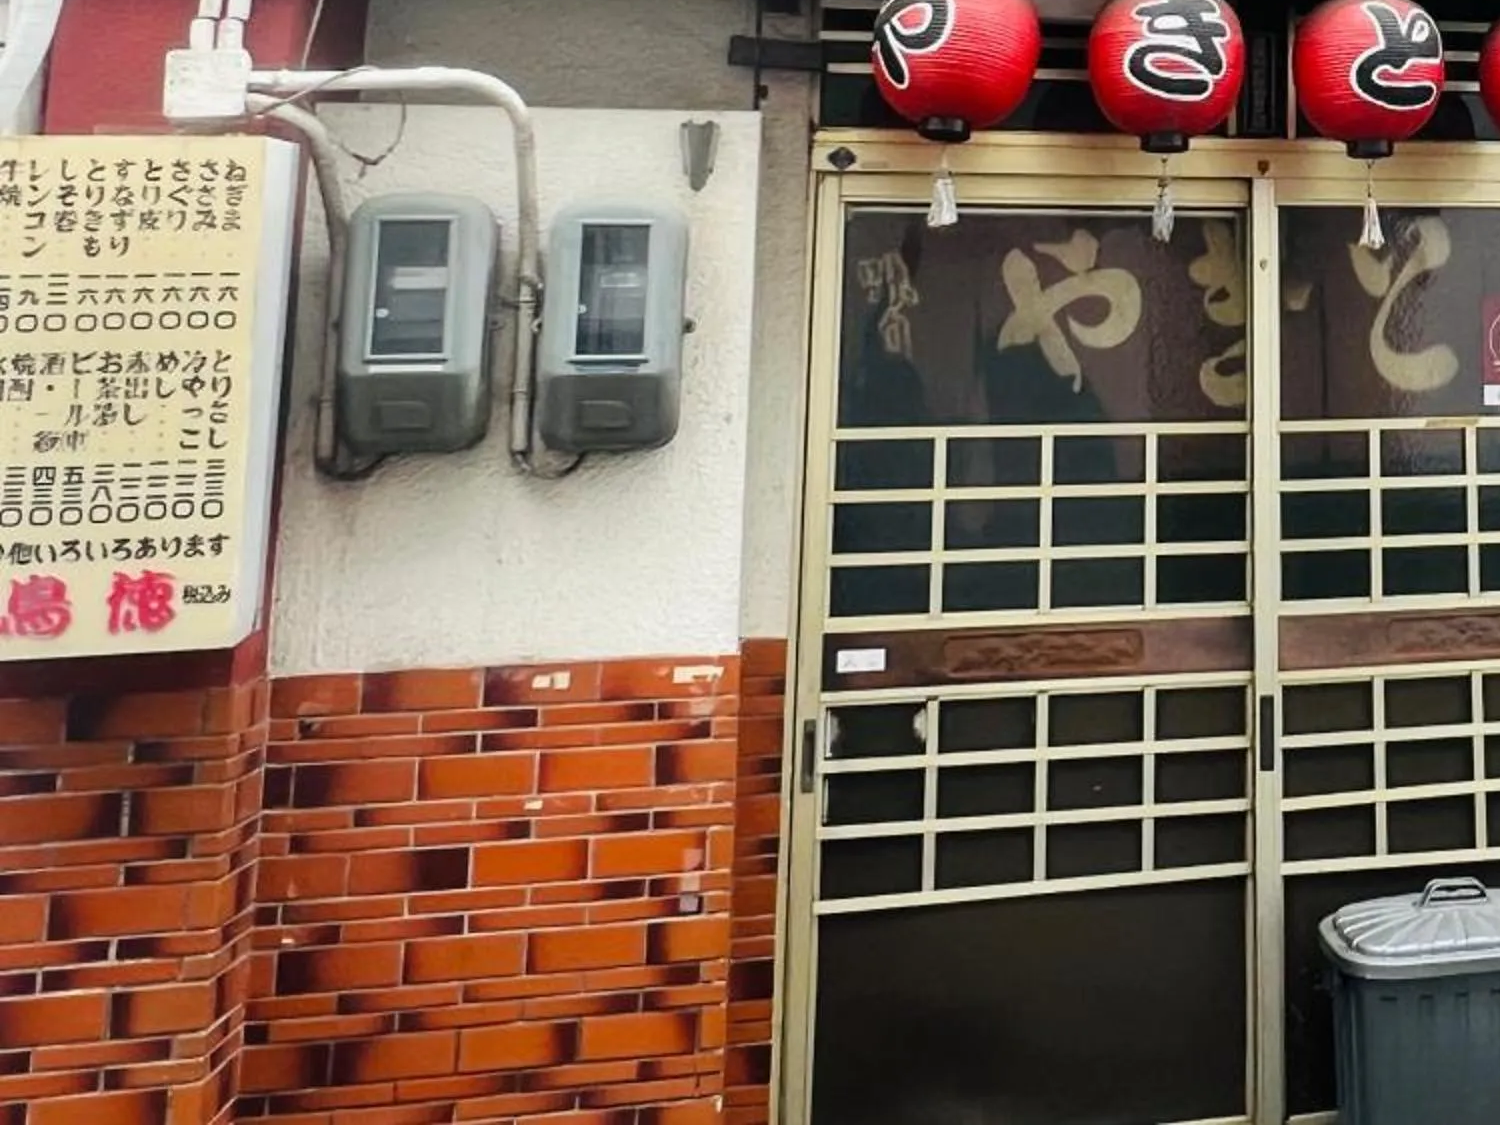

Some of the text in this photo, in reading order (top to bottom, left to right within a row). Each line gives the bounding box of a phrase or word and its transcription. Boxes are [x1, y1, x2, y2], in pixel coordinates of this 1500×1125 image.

[22, 159, 51, 258] レンコン
[110, 159, 137, 257] すなずり
[192, 159, 220, 232] ささみ
[156, 350, 180, 399] めし
[0, 533, 231, 565] 他いろいろあります
